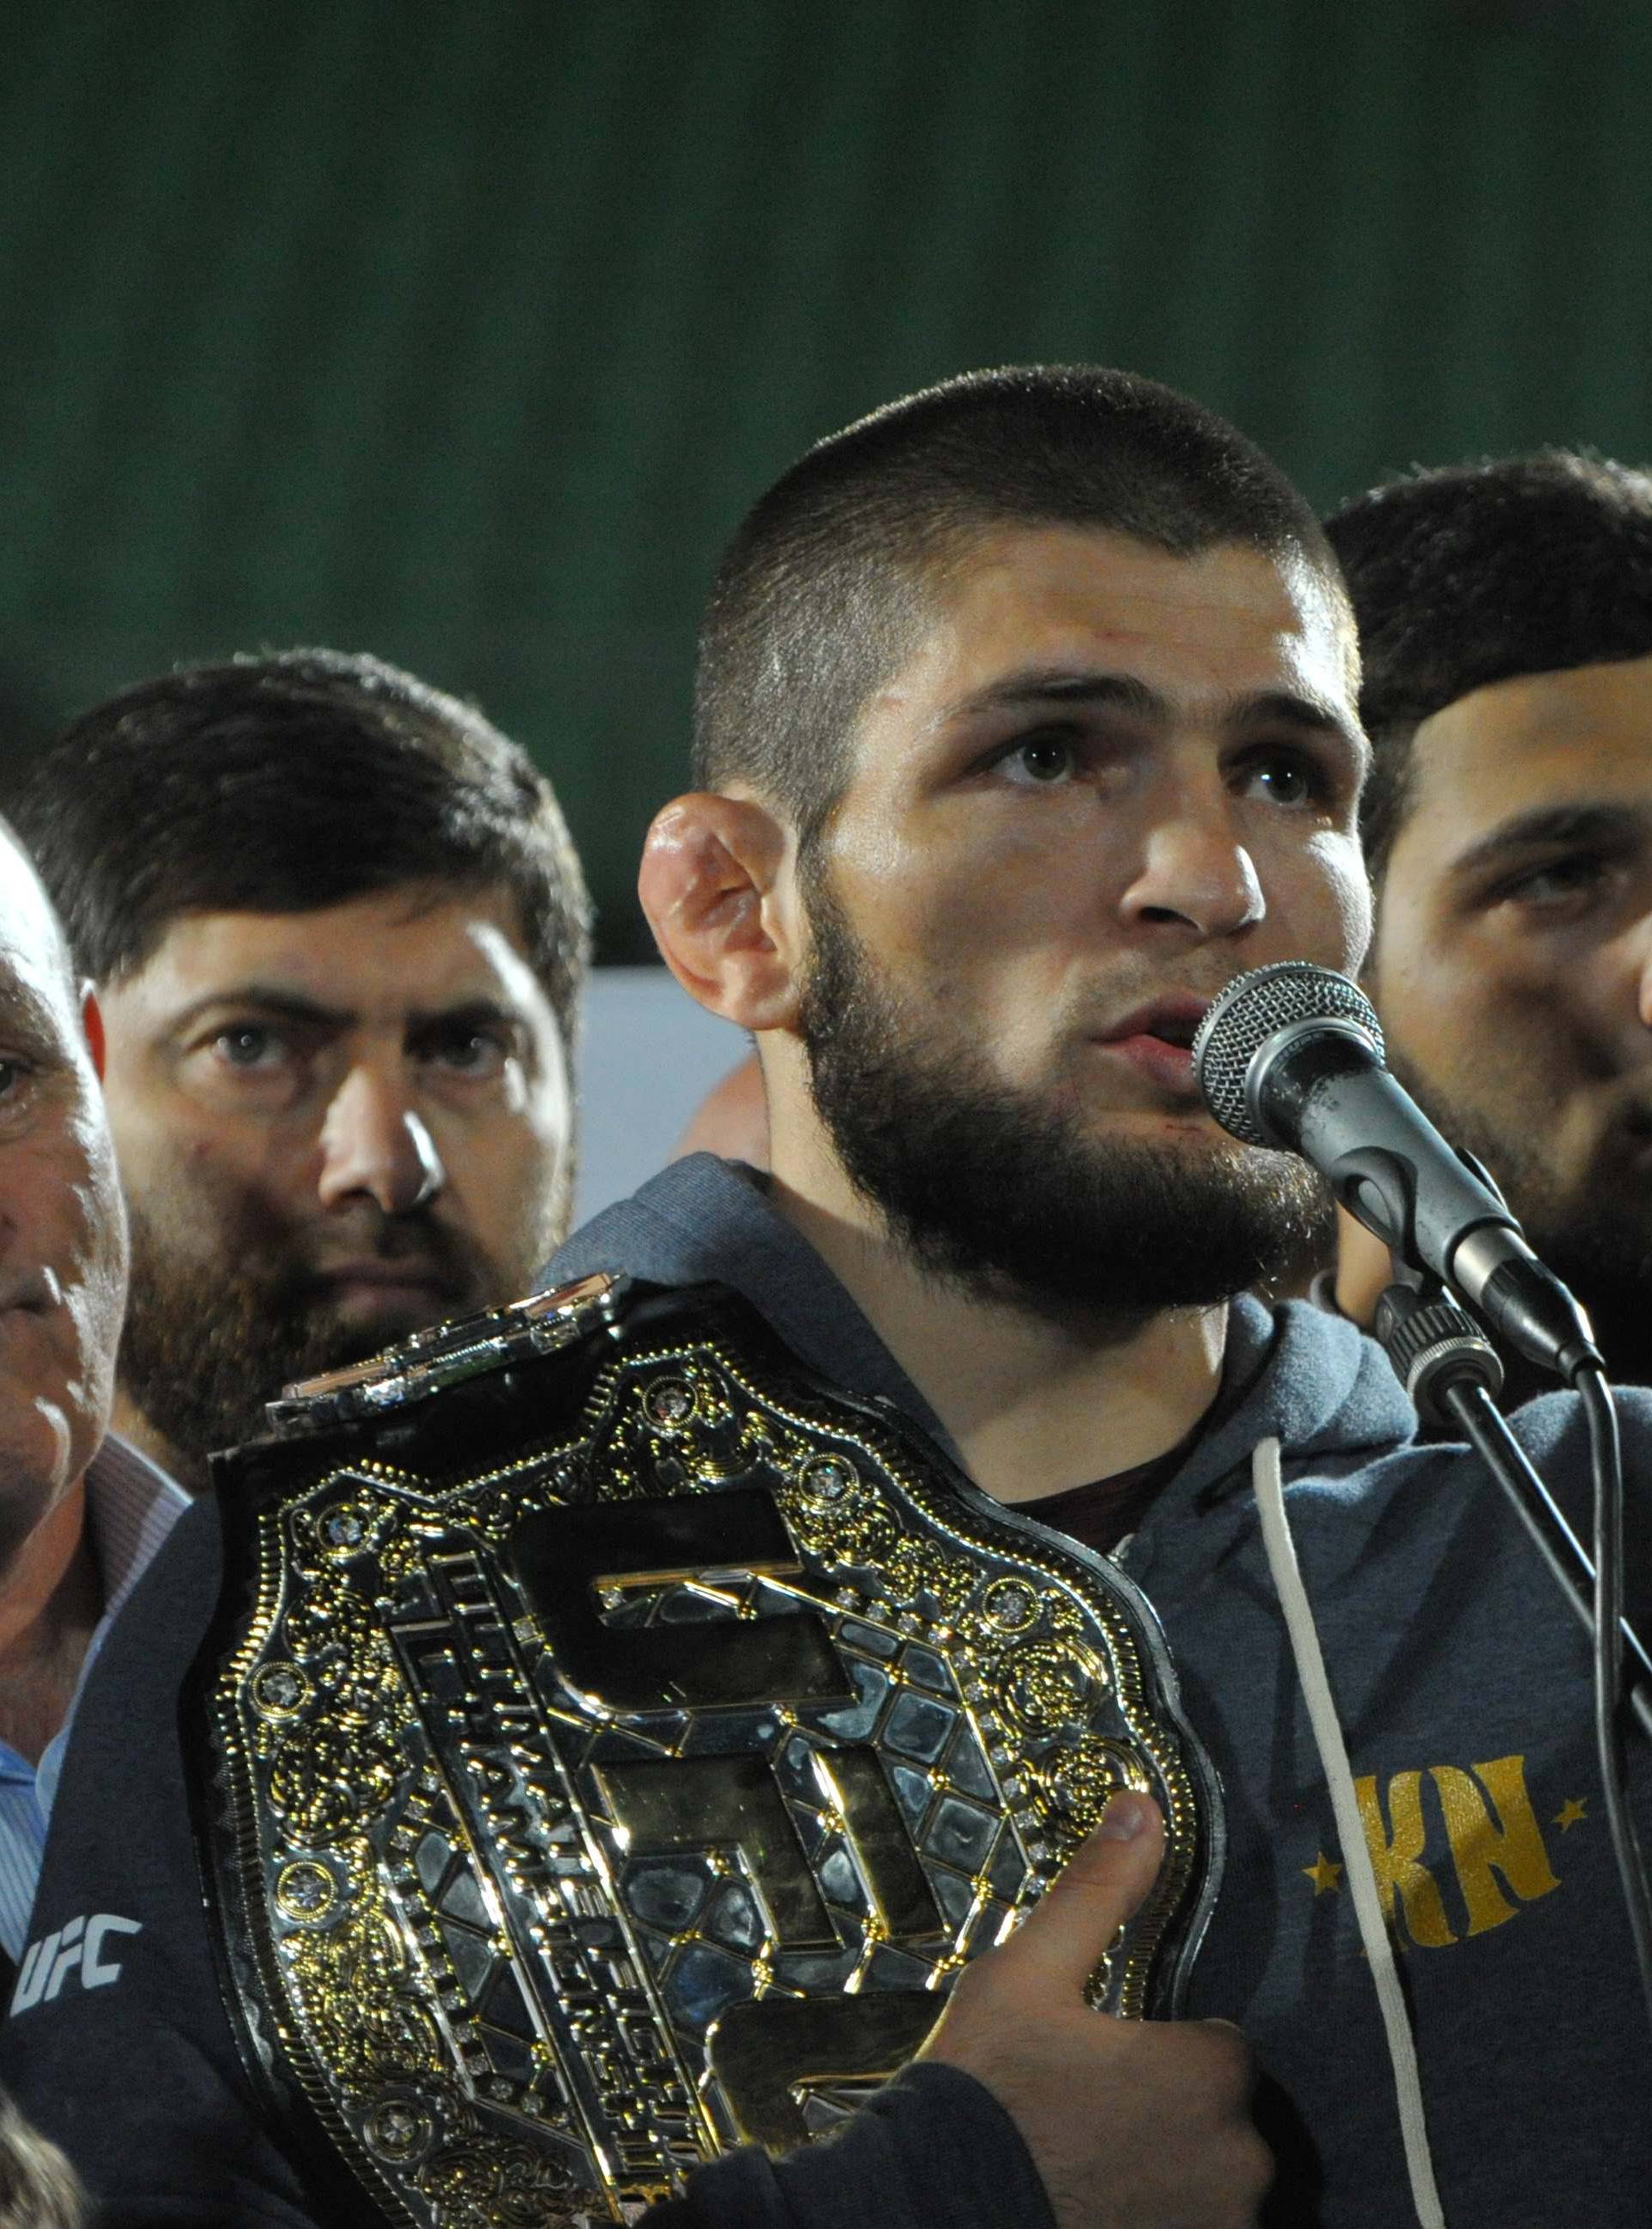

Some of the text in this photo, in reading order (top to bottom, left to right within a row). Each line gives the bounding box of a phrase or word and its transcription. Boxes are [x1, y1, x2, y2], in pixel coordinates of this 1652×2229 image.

[427, 1553, 710, 2190] ULTIMATE FIGHT
[1354, 1756, 1562, 1956] KN
[9, 1913, 143, 2017] UFC
